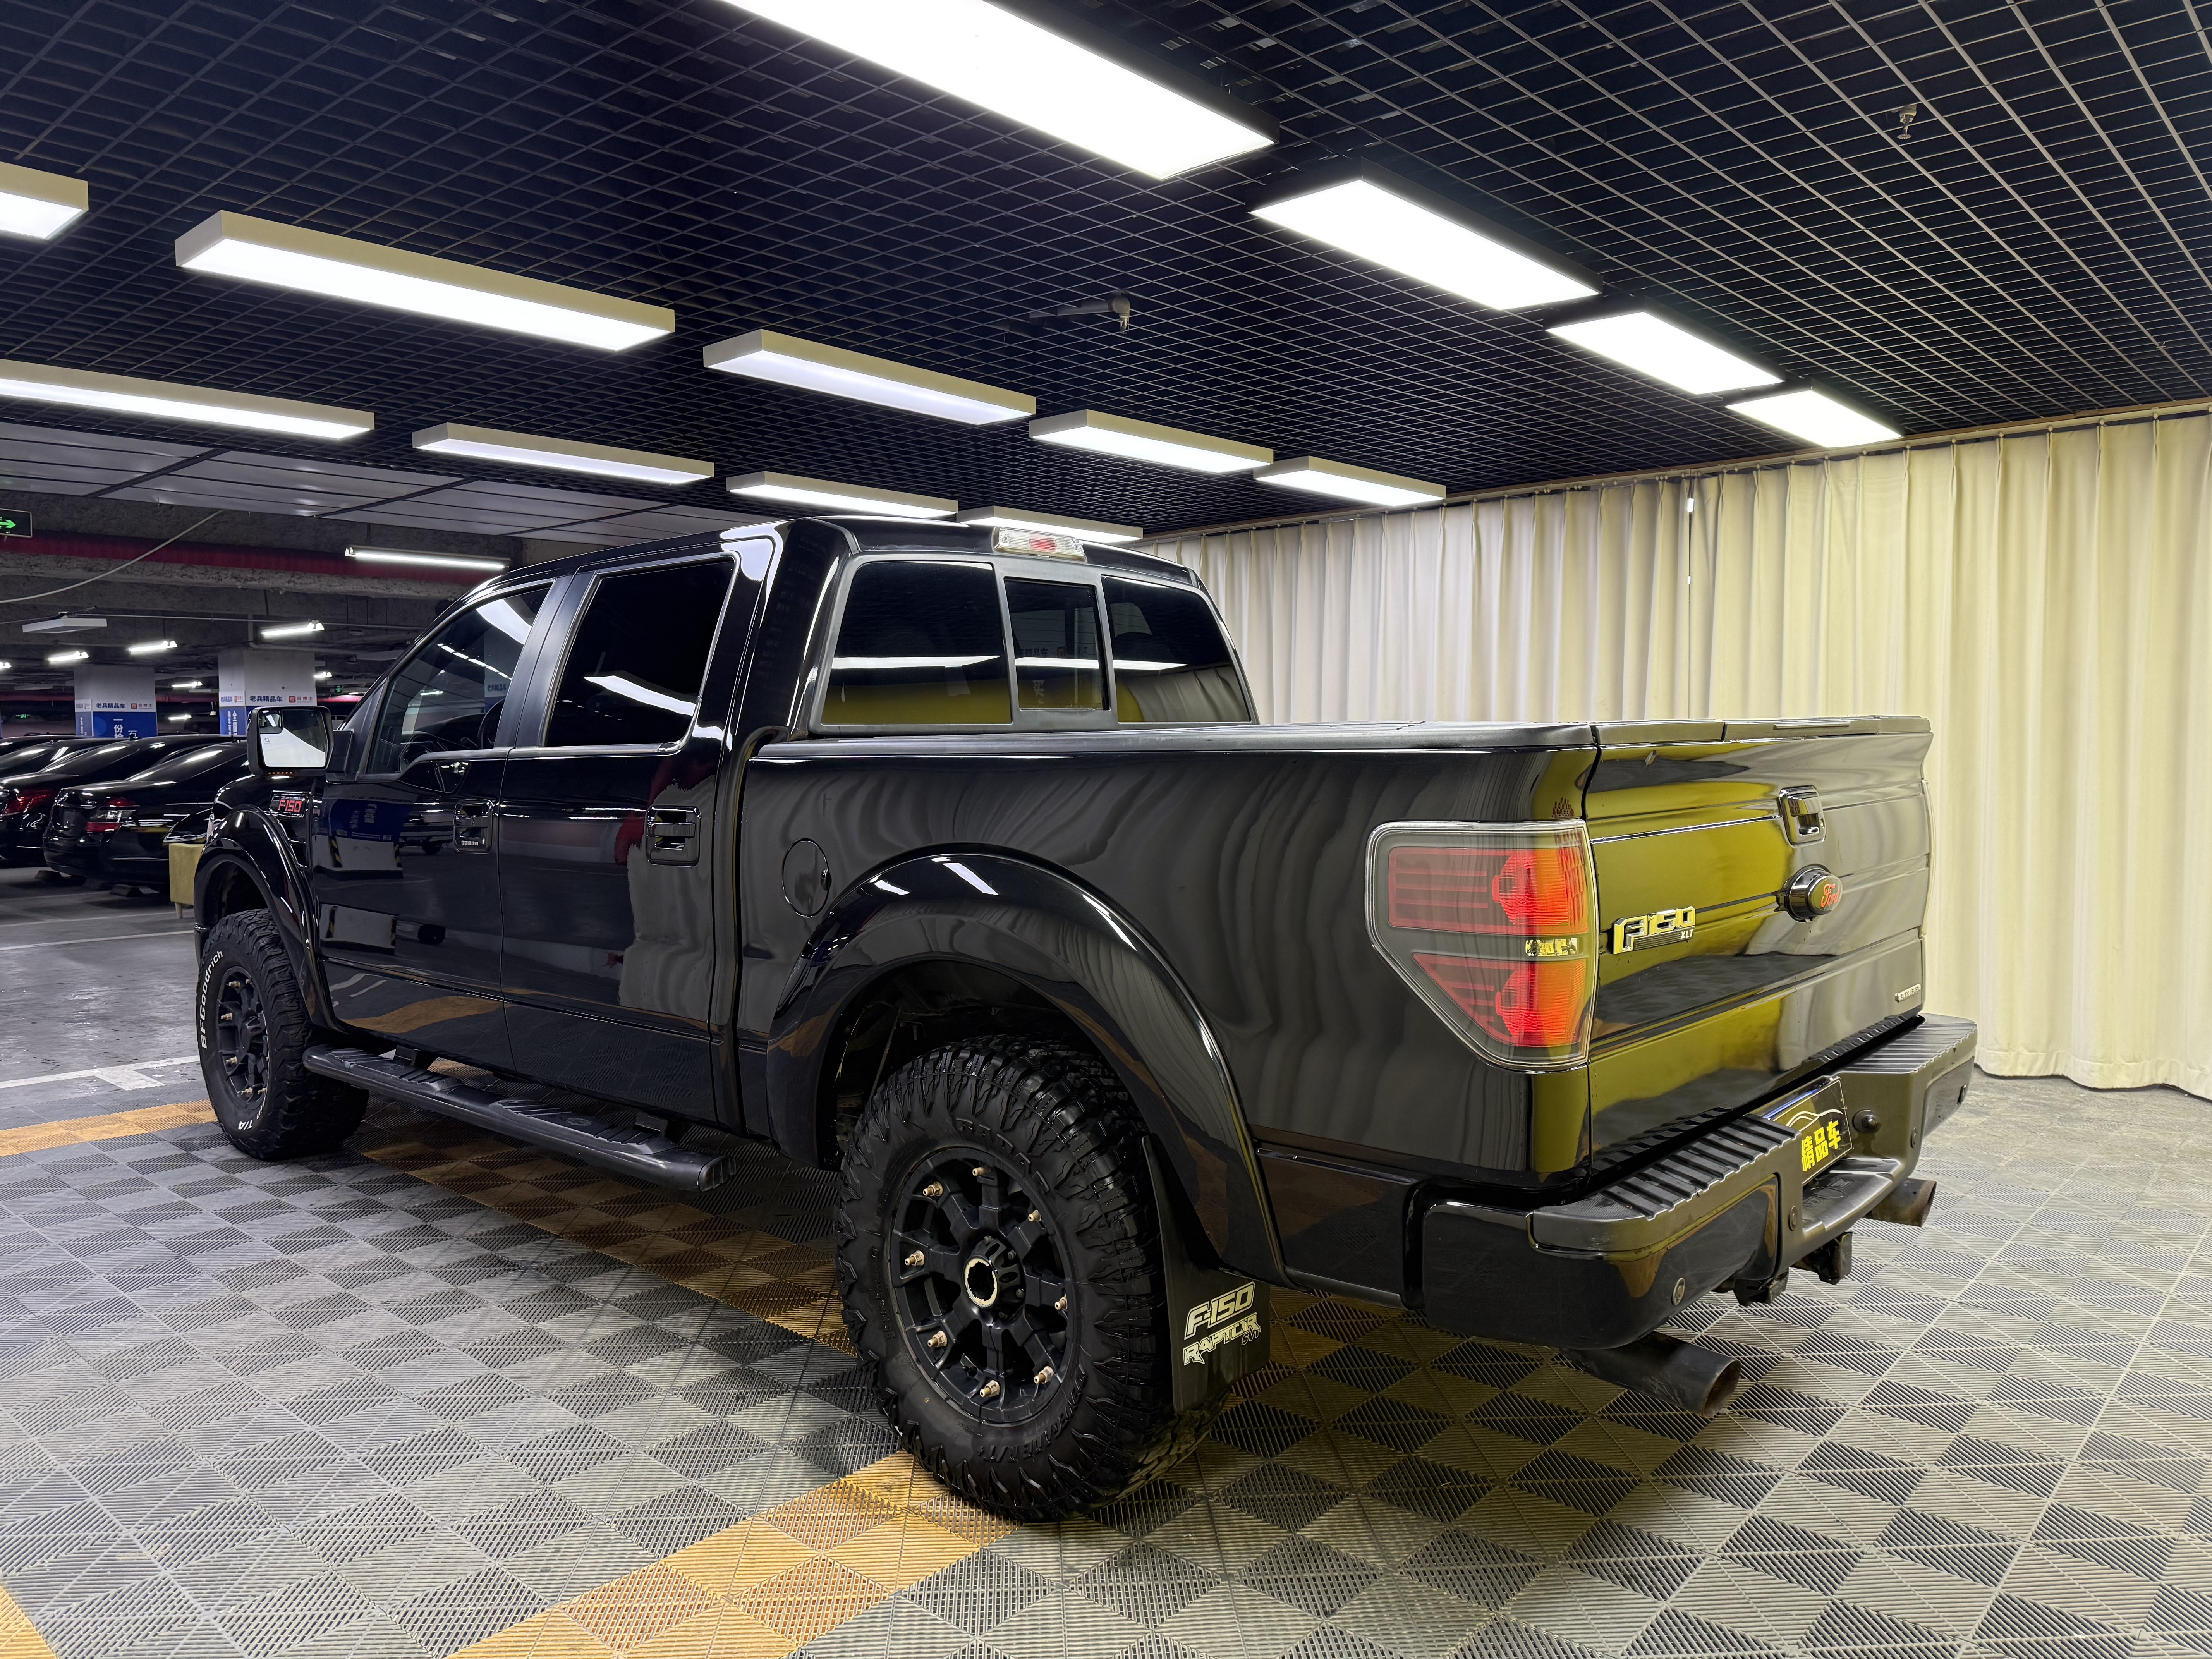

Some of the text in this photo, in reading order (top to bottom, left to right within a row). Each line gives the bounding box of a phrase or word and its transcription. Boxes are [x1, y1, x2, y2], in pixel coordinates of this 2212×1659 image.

[1821, 883, 1840, 907] Ford
[1680, 929, 1694, 939] XLT
[200, 950, 223, 1049] BFGoodrich
[238, 1119, 253, 1130] T/A
[1801, 1120, 1841, 1172] 精品车
[1184, 1281, 1255, 1340] F-150
[1183, 1312, 1262, 1366] RAPTOR
